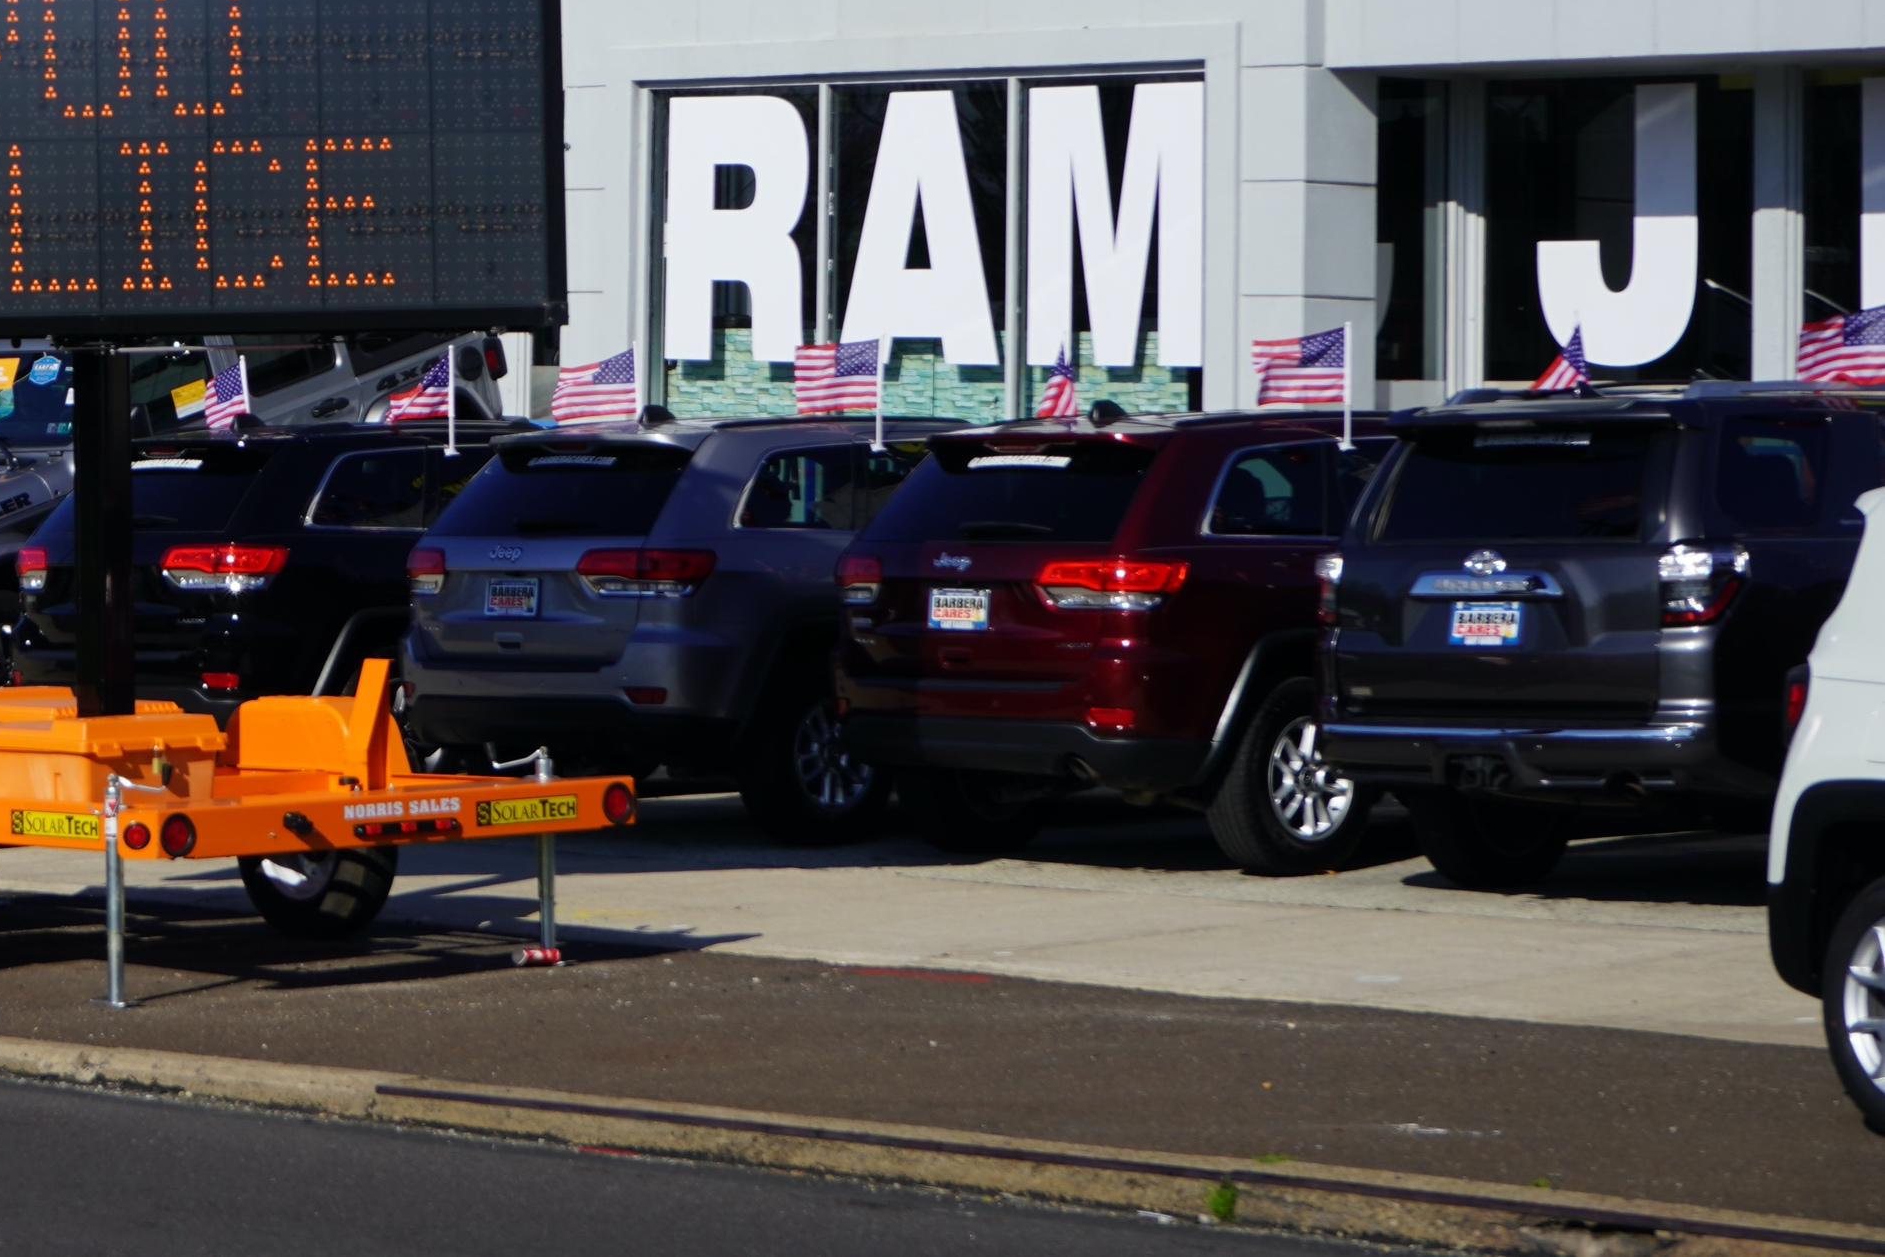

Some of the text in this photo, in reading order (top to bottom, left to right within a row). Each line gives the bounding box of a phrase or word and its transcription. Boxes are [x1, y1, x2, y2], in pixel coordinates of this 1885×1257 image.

[664, 80, 1204, 367] RAM
[489, 545, 523, 562] Jeep
[490, 586, 534, 597] BARBERA
[490, 597, 524, 606] CARES
[933, 597, 983, 608] BARBERA
[933, 608, 971, 619] CARES
[1455, 612, 1517, 624] BARBERA
[1455, 624, 1501, 635] CARES
[343, 796, 461, 820] NORRIS SALES
